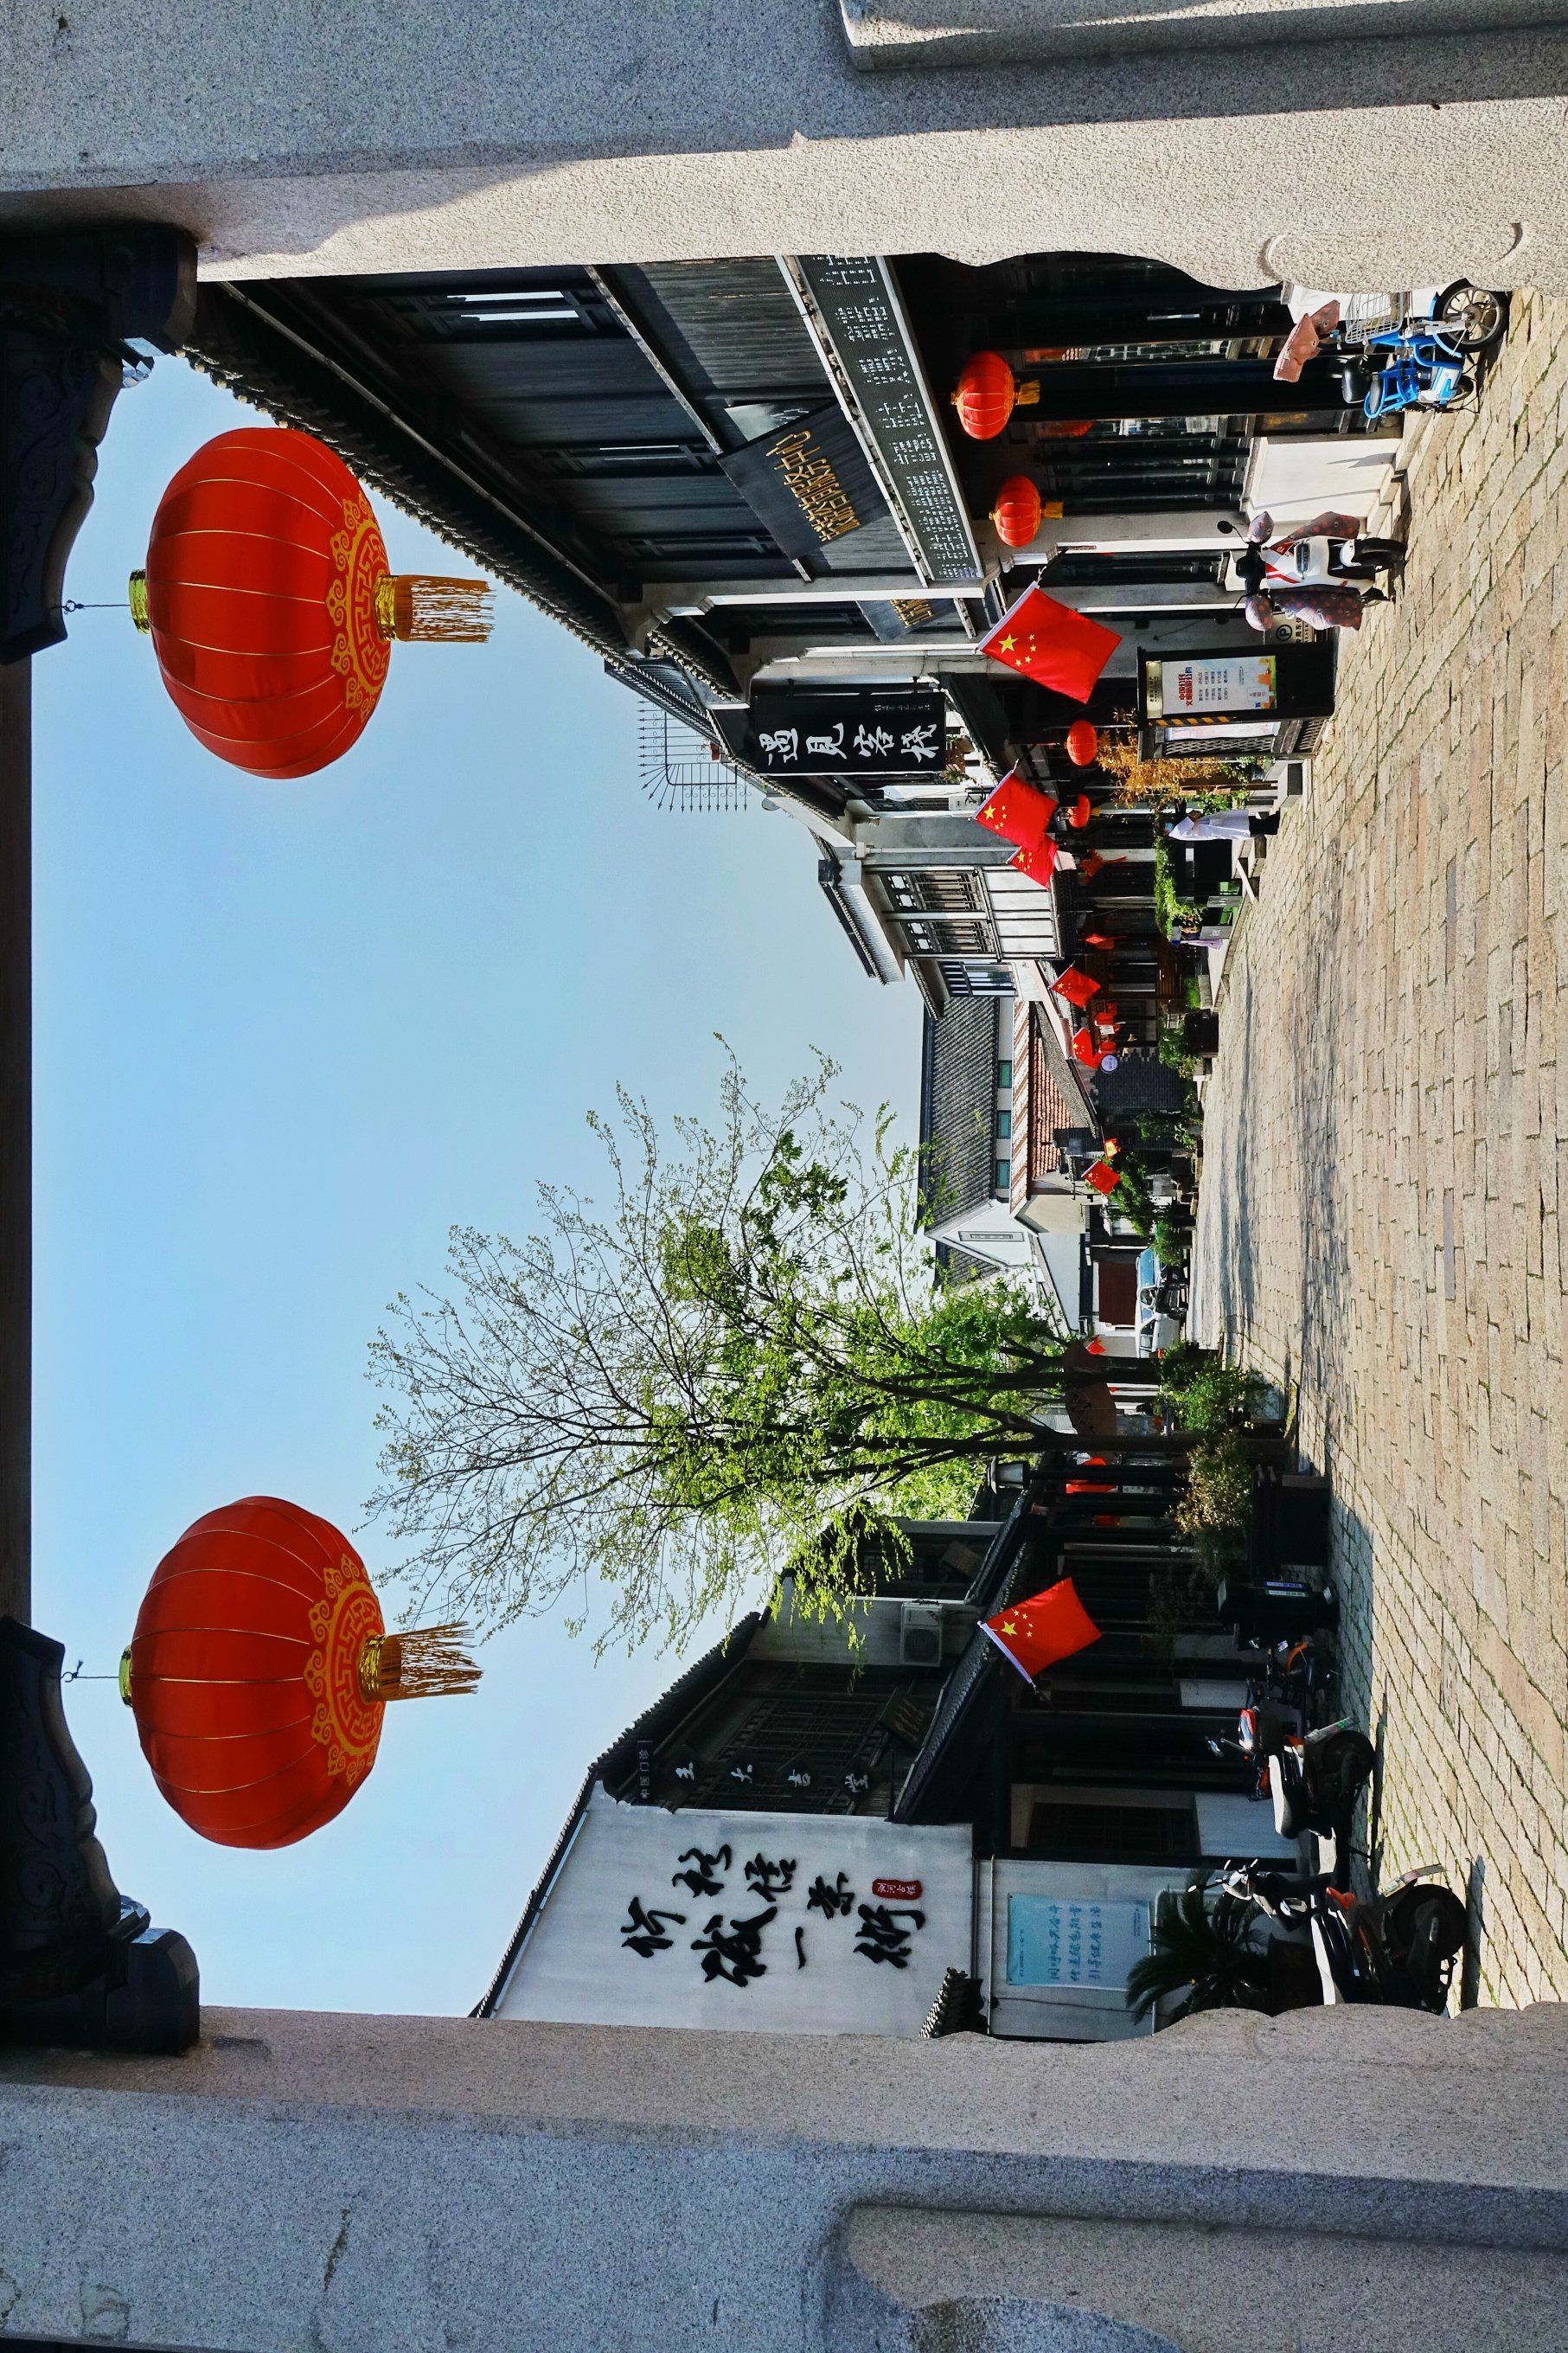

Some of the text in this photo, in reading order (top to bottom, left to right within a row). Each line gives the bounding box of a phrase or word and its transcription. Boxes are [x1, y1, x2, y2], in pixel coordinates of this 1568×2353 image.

[765, 430, 861, 542] 旅游咨询服务中心
[674, 1761, 869, 1794] 王大吉堂
